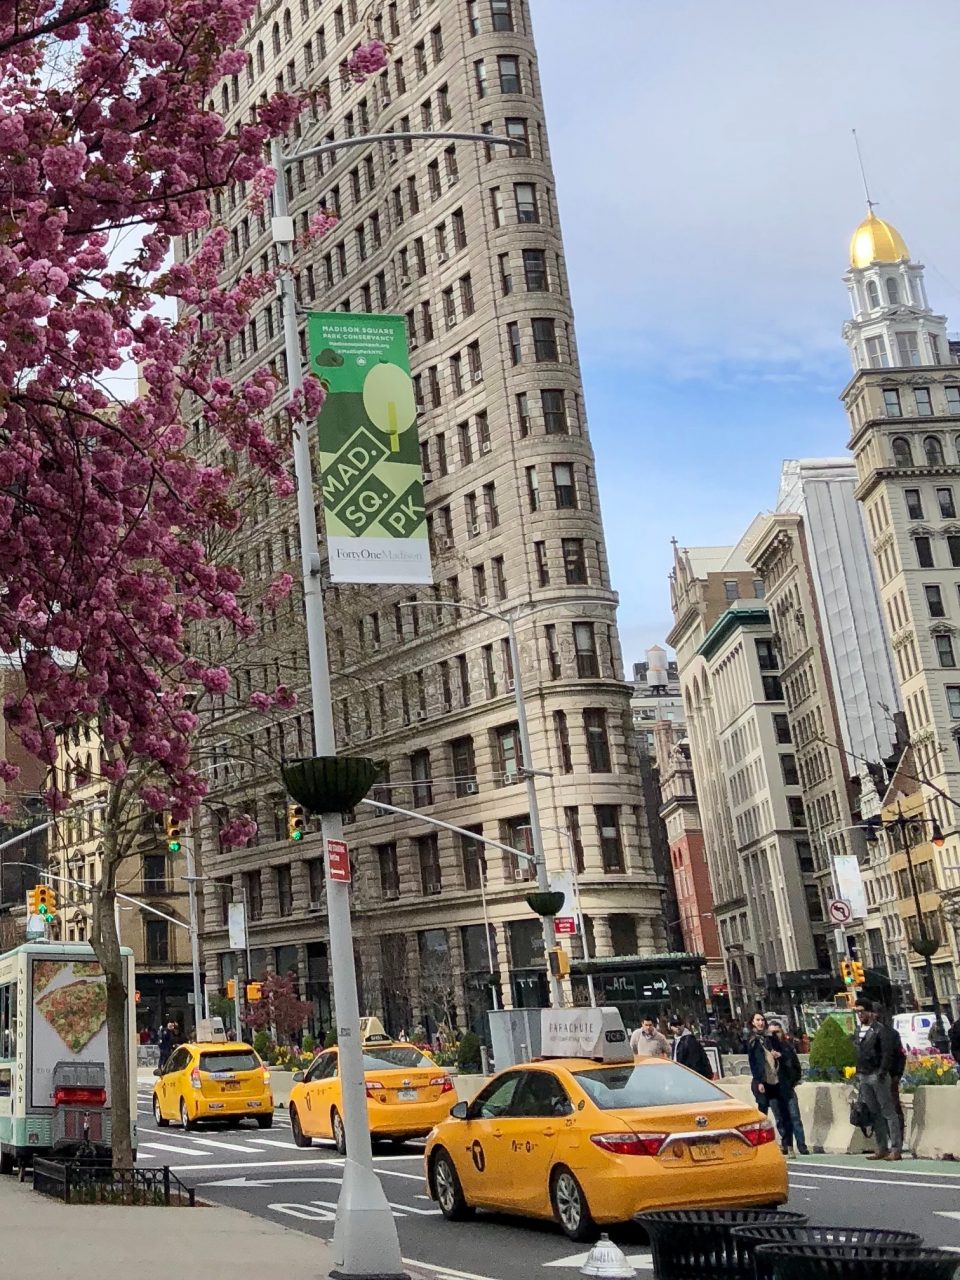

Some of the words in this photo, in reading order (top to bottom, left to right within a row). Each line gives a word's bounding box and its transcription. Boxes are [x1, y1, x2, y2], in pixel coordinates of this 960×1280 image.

[322, 325, 360, 334] MADISON
[362, 327, 394, 335] SQUARE
[342, 334, 395, 342] CONSERVANCY
[322, 446, 377, 502] MAD.
[345, 490, 389, 528] SQ.
[387, 495, 426, 535] PK
[549, 1023, 593, 1033] PARACHUTE
[17, 1051, 25, 1105] TOAST
